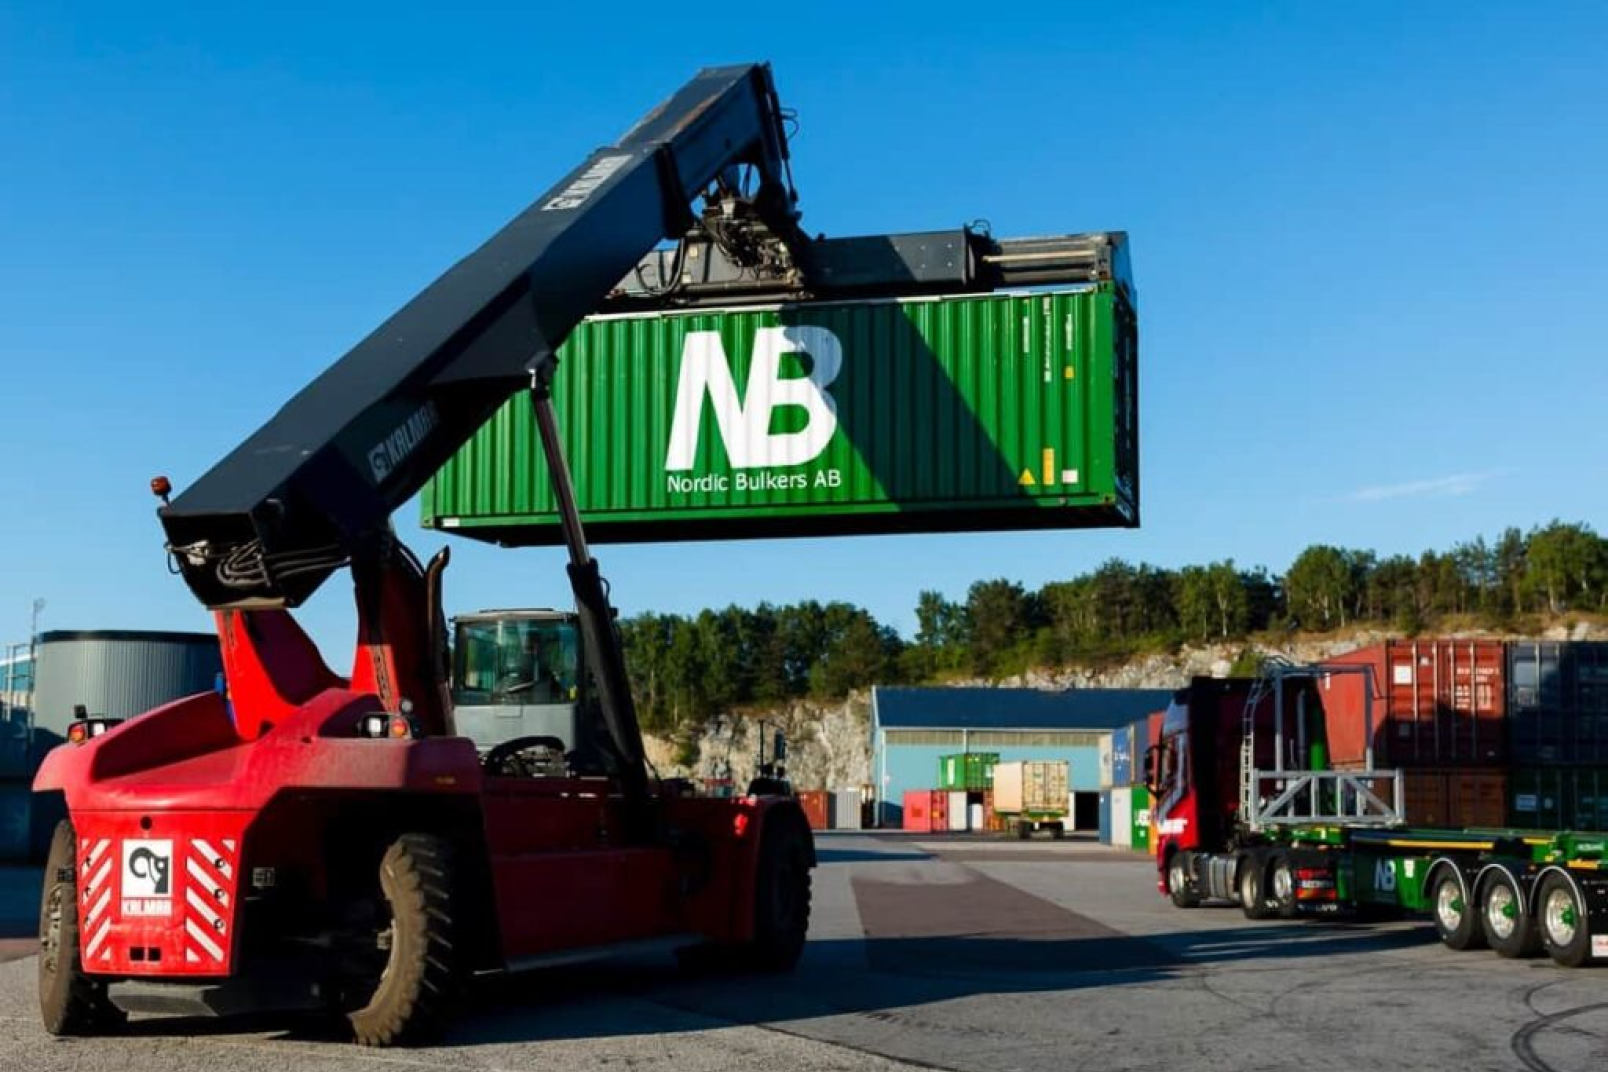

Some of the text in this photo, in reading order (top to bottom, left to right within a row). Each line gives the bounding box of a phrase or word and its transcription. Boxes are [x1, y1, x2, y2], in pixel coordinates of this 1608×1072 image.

[665, 325, 842, 471] NB
[667, 469, 842, 493] Nordic Bulkers AB
[1374, 857, 1397, 892] NB
